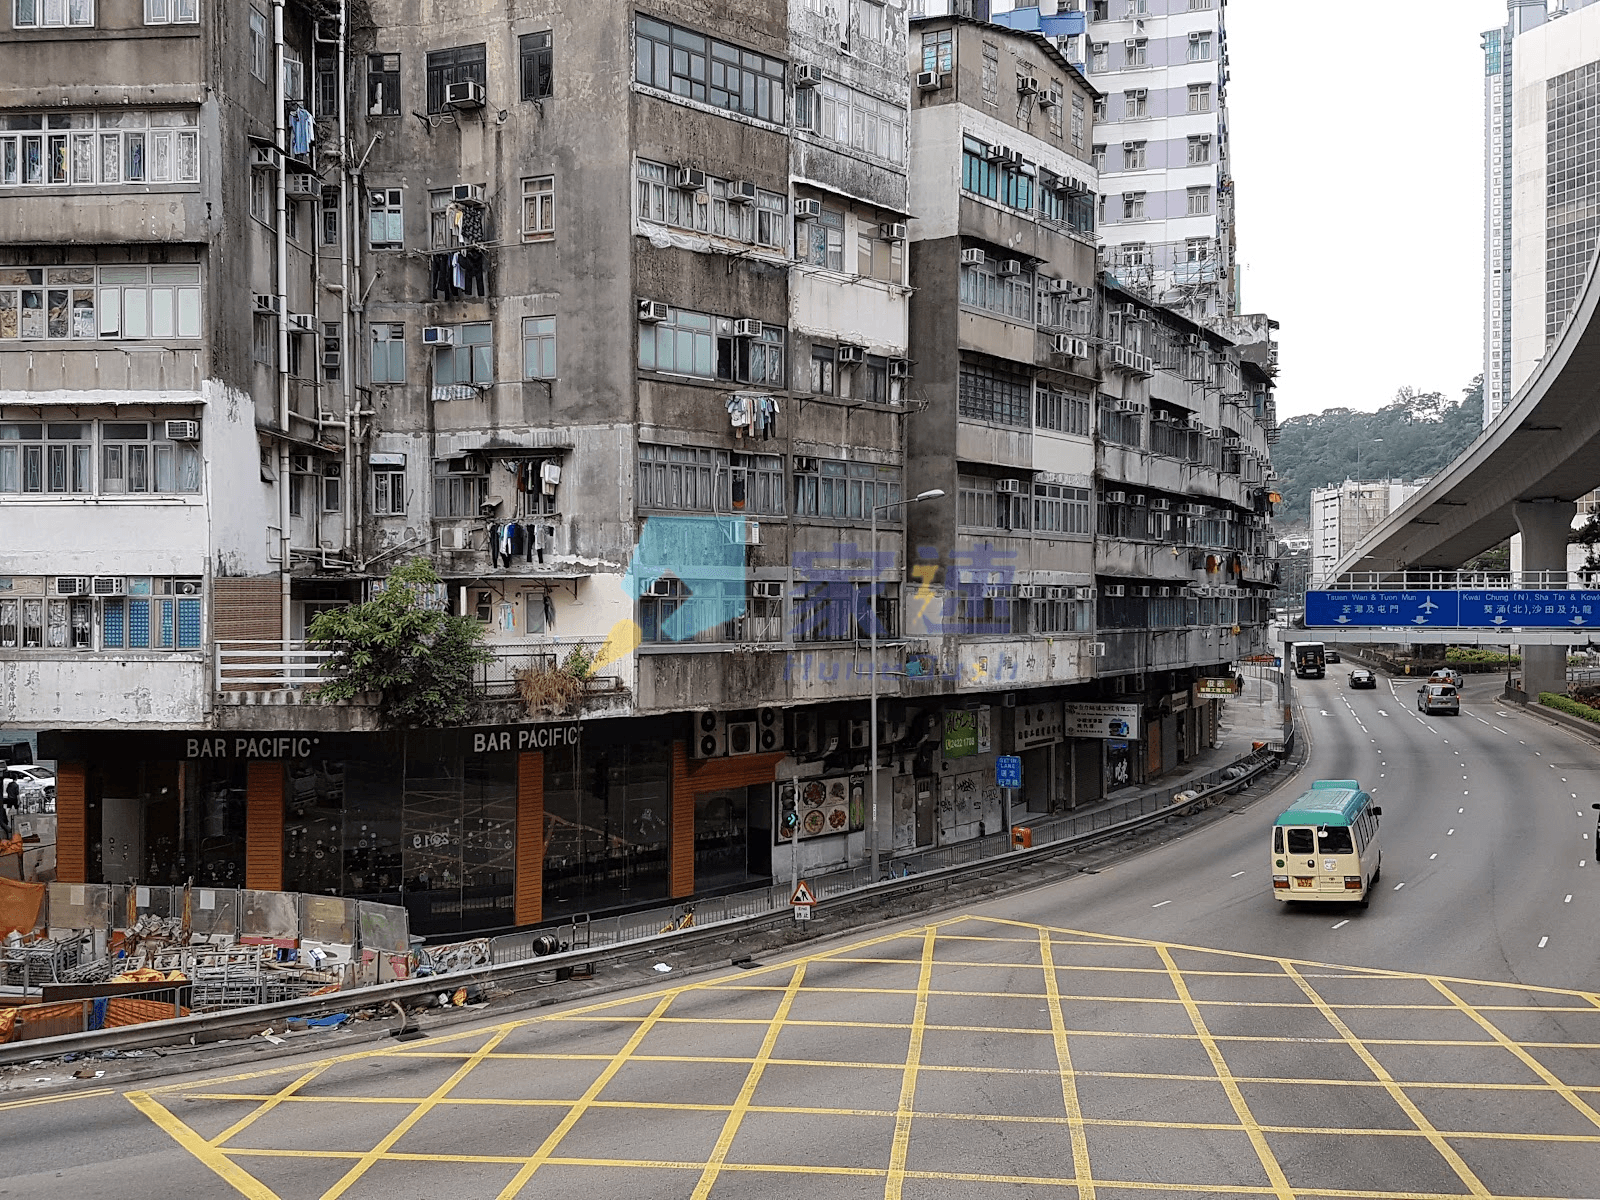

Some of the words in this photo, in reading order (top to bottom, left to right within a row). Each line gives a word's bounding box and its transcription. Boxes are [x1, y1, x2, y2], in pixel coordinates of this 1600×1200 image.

[1485, 594, 1509, 602] Chung
[186, 738, 227, 758] BAR
[235, 737, 311, 758] PACIFIC
[473, 732, 511, 753] BAR
[518, 726, 578, 749] PACIFIC
